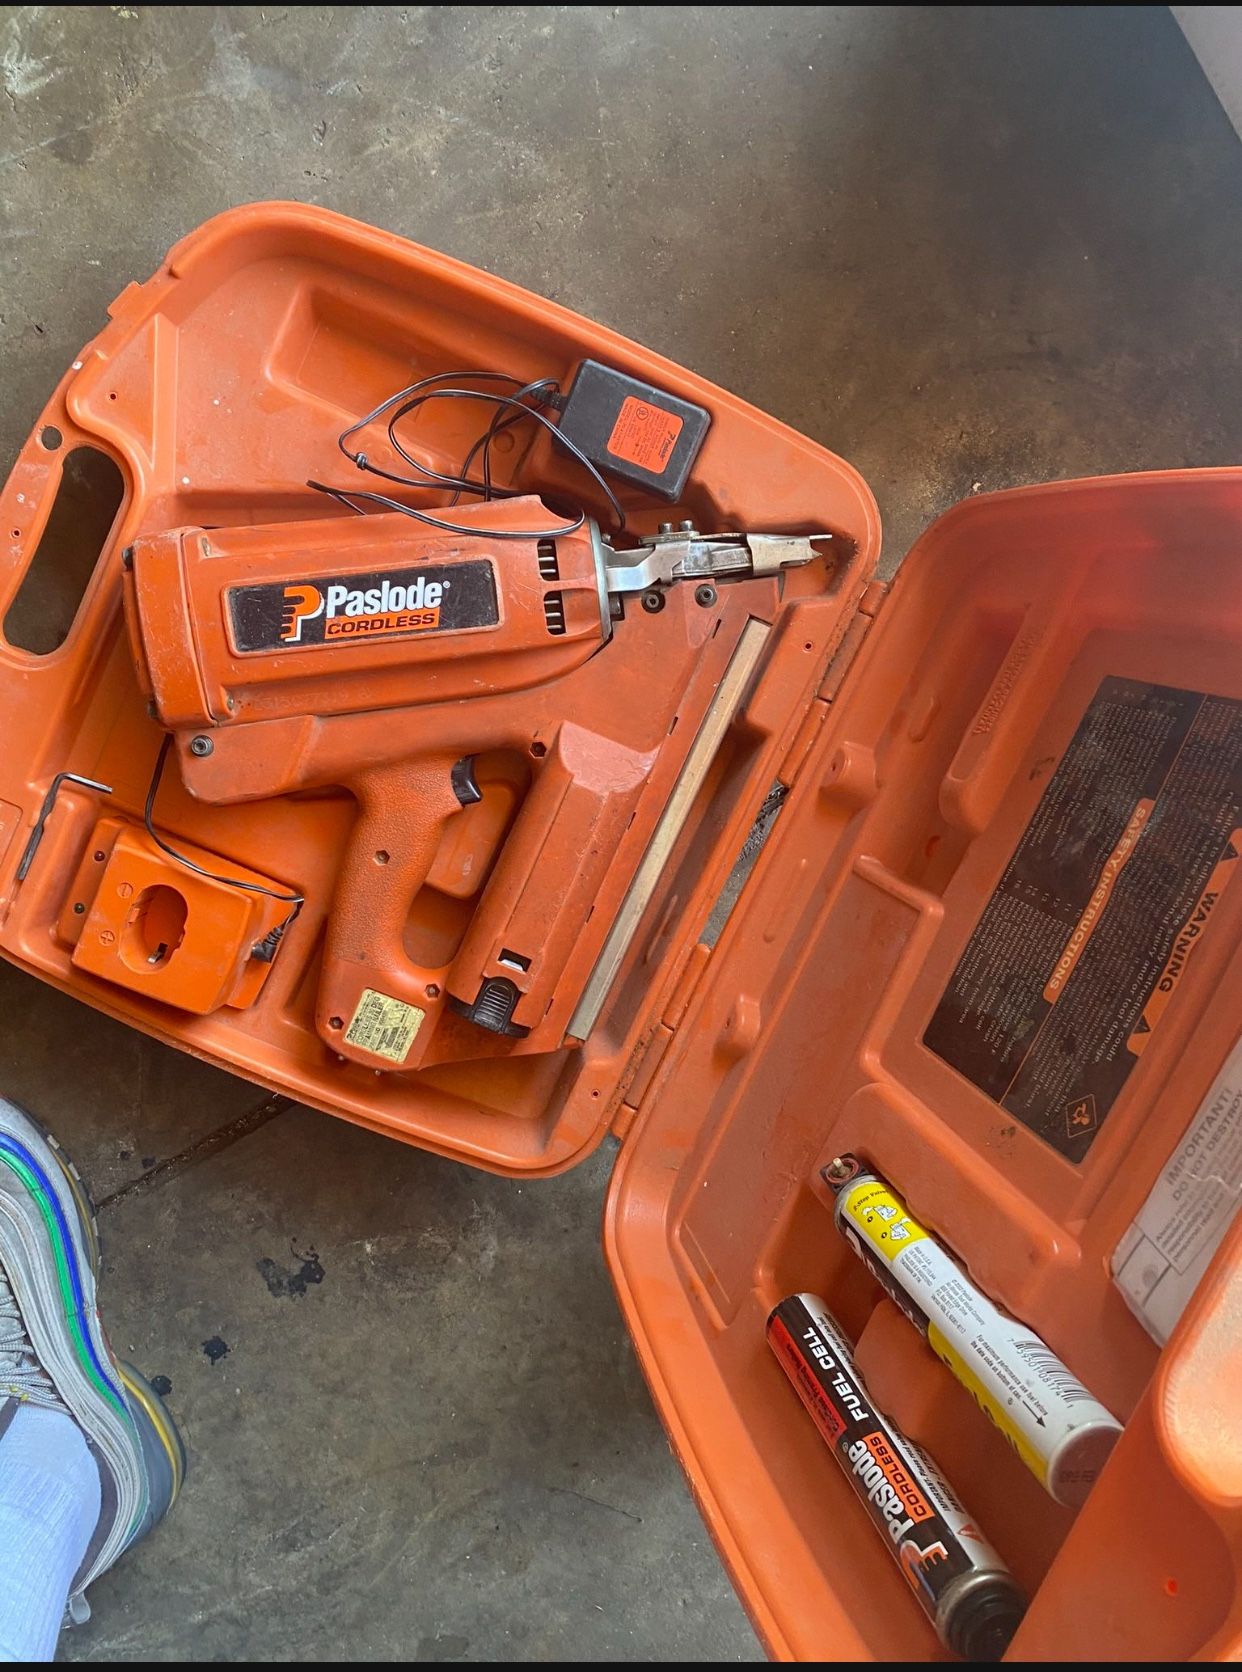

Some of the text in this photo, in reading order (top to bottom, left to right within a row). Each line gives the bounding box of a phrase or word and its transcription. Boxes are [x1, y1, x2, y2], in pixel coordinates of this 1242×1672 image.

[326, 576, 443, 619] Paslode
[328, 612, 436, 635] CORDLESS
[1106, 805, 1146, 869] SAFETY
[1047, 870, 1113, 991] INSTRUCTIONS
[1090, 790, 1235, 1066] result in severe personal injury and/or tool damage.
[1104, 804, 1241, 1062] Failure to follow these safety instructions could
[1156, 893, 1219, 994] WARNING
[1171, 1179, 1190, 1201] DO
[1186, 1152, 1207, 1180] NOT
[802, 1325, 836, 1371] CELL
[975, 1346, 986, 1358] date
[982, 1354, 995, 1368] code
[995, 1370, 1012, 1387] bottom
[980, 1340, 1000, 1361] maximum
[996, 1359, 1021, 1386] performance
[1025, 1391, 1037, 1403] fuel
[1033, 1400, 1049, 1416] before
[830, 1370, 869, 1422] FUEL
[846, 1438, 915, 1545] Paslode
[869, 1434, 927, 1517] CORDLESS
